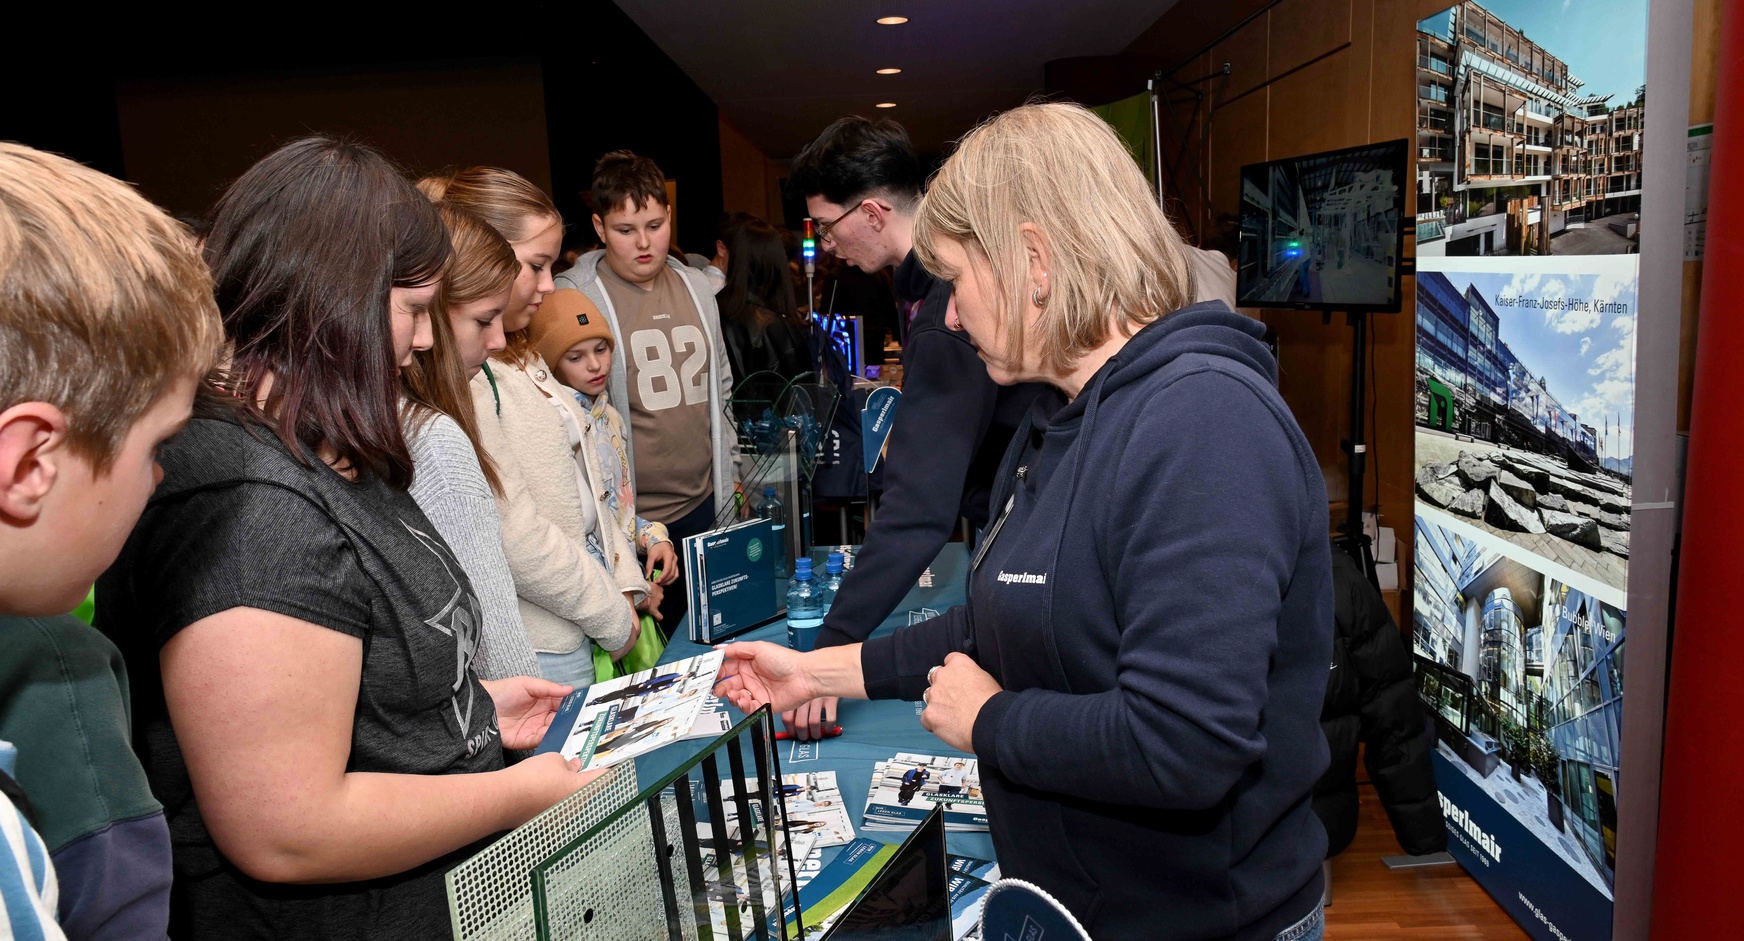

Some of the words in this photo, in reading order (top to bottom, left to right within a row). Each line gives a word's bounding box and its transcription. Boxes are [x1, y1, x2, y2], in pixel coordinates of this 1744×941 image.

[1495, 294, 1591, 314] Kaiser-Franz-Josefs-Höhe,
[1593, 299, 1628, 314] Kärnten
[630, 325, 708, 411] 82
[872, 395, 894, 432] Gasperlmair
[1593, 620, 1616, 644] Wien
[798, 744, 811, 759] GLAS
[1437, 790, 1502, 863] sperlmair
[1518, 891, 1571, 941] www.glas-gaspe
